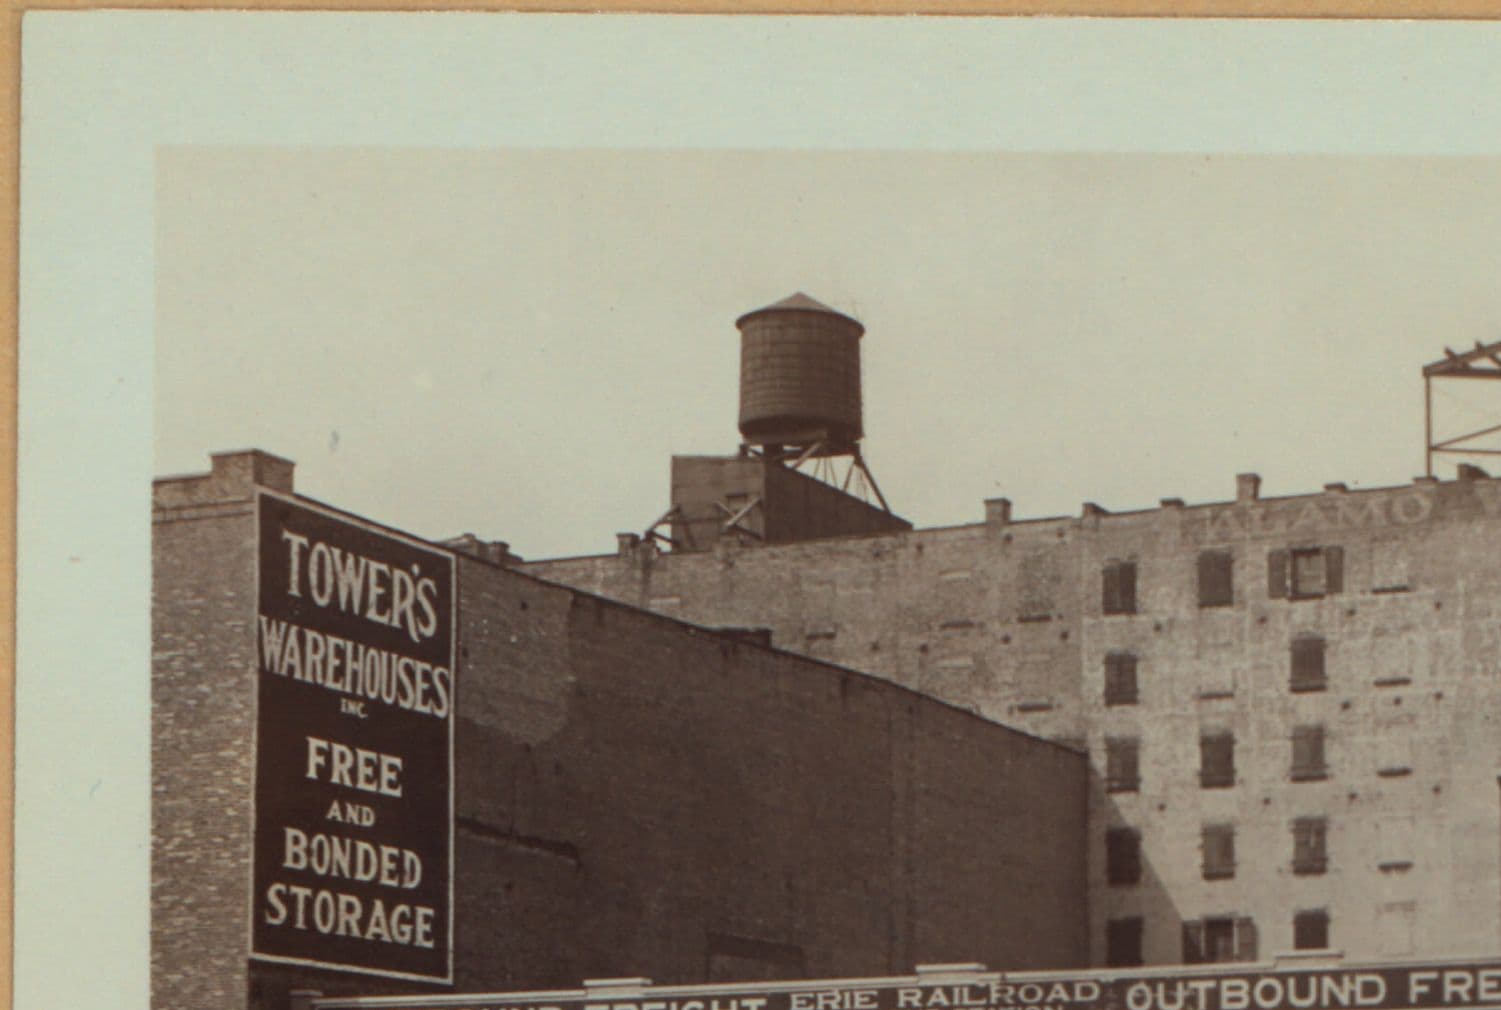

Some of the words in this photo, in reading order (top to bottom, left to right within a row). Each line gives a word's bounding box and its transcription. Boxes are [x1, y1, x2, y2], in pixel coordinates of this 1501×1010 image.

[281, 528, 437, 643] TOWER'S
[259, 614, 449, 719] WAREHOUSES
[306, 736, 402, 797] FREE
[326, 800, 375, 827] AND
[283, 827, 422, 889] BONDED
[265, 882, 435, 948] STORAGE
[898, 981, 1100, 1009] RAILROAD
